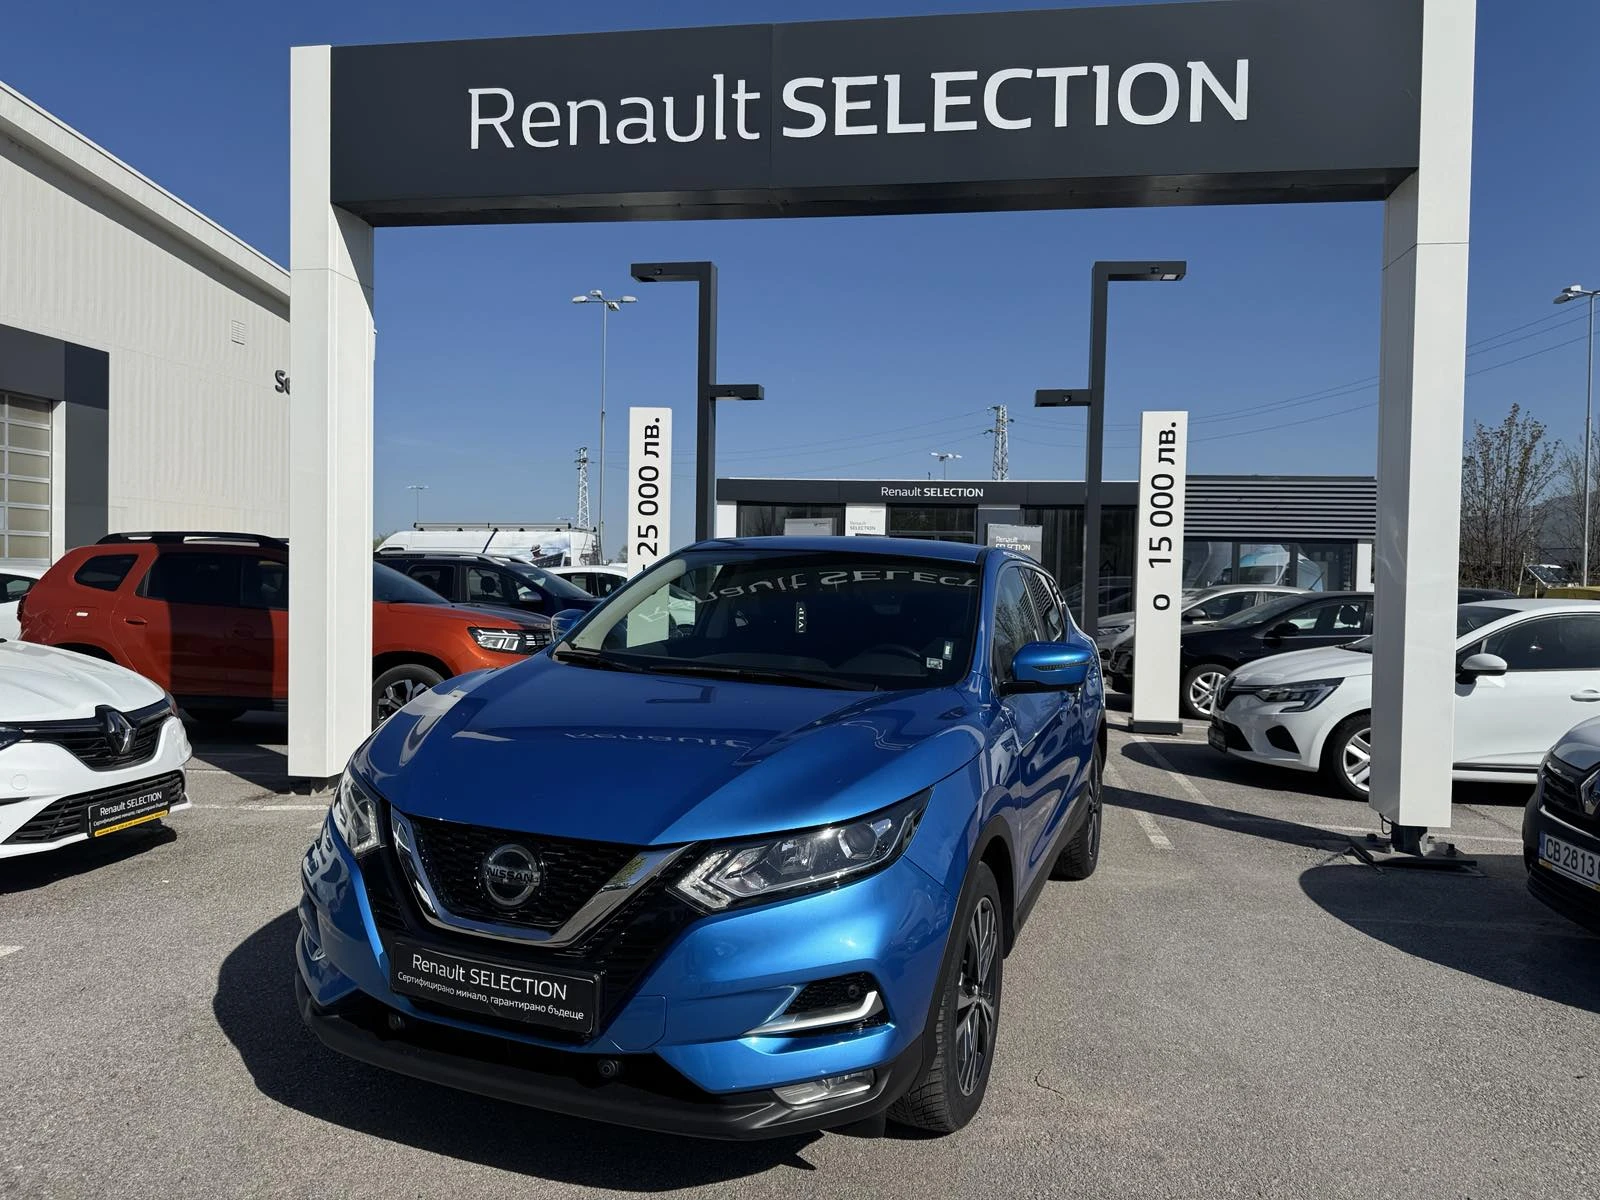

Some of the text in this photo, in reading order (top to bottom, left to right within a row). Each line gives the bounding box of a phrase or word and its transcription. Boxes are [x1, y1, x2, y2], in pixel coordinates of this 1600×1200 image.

[468, 58, 1250, 149] Renault SELECTION
[644, 417, 660, 458] лв.
[1158, 422, 1177, 465] лв.
[638, 465, 659, 516] 000
[881, 487, 984, 498] Renault SELECTION
[1150, 473, 1175, 528] 000
[637, 524, 659, 557] 25
[1149, 536, 1173, 569] 15
[100, 800, 126, 816] Renault
[126, 791, 162, 809] SELECTION
[487, 867, 533, 882] NISSAN
[1563, 846, 1595, 878] 2813
[397, 971, 585, 1020] Сертифицирано минало, гарантирано бъдеще
[412, 953, 567, 1000] Renault SELECTION
